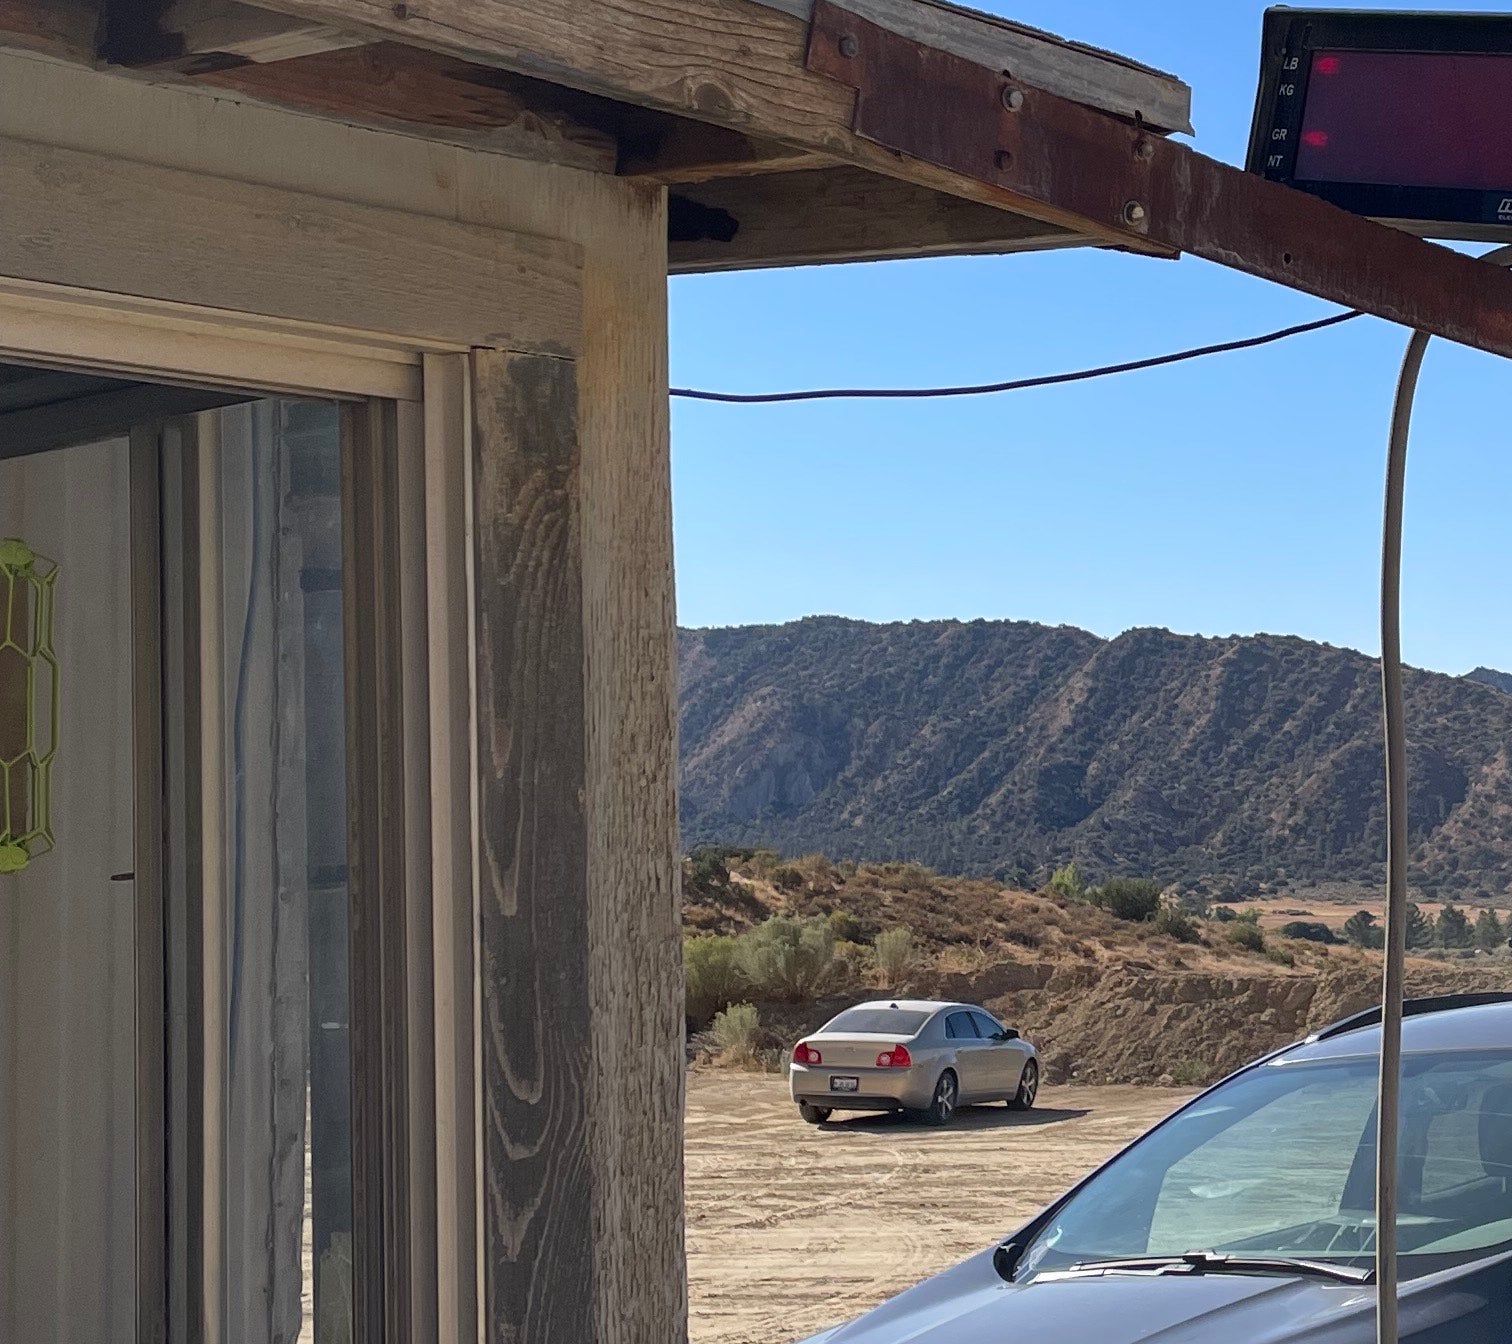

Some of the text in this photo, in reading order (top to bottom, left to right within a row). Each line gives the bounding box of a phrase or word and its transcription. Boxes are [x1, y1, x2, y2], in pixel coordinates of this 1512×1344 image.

[1283, 57, 1299, 70] LB
[1279, 84, 1295, 96] KG
[1271, 128, 1288, 141] GR
[1267, 155, 1284, 168] NT
